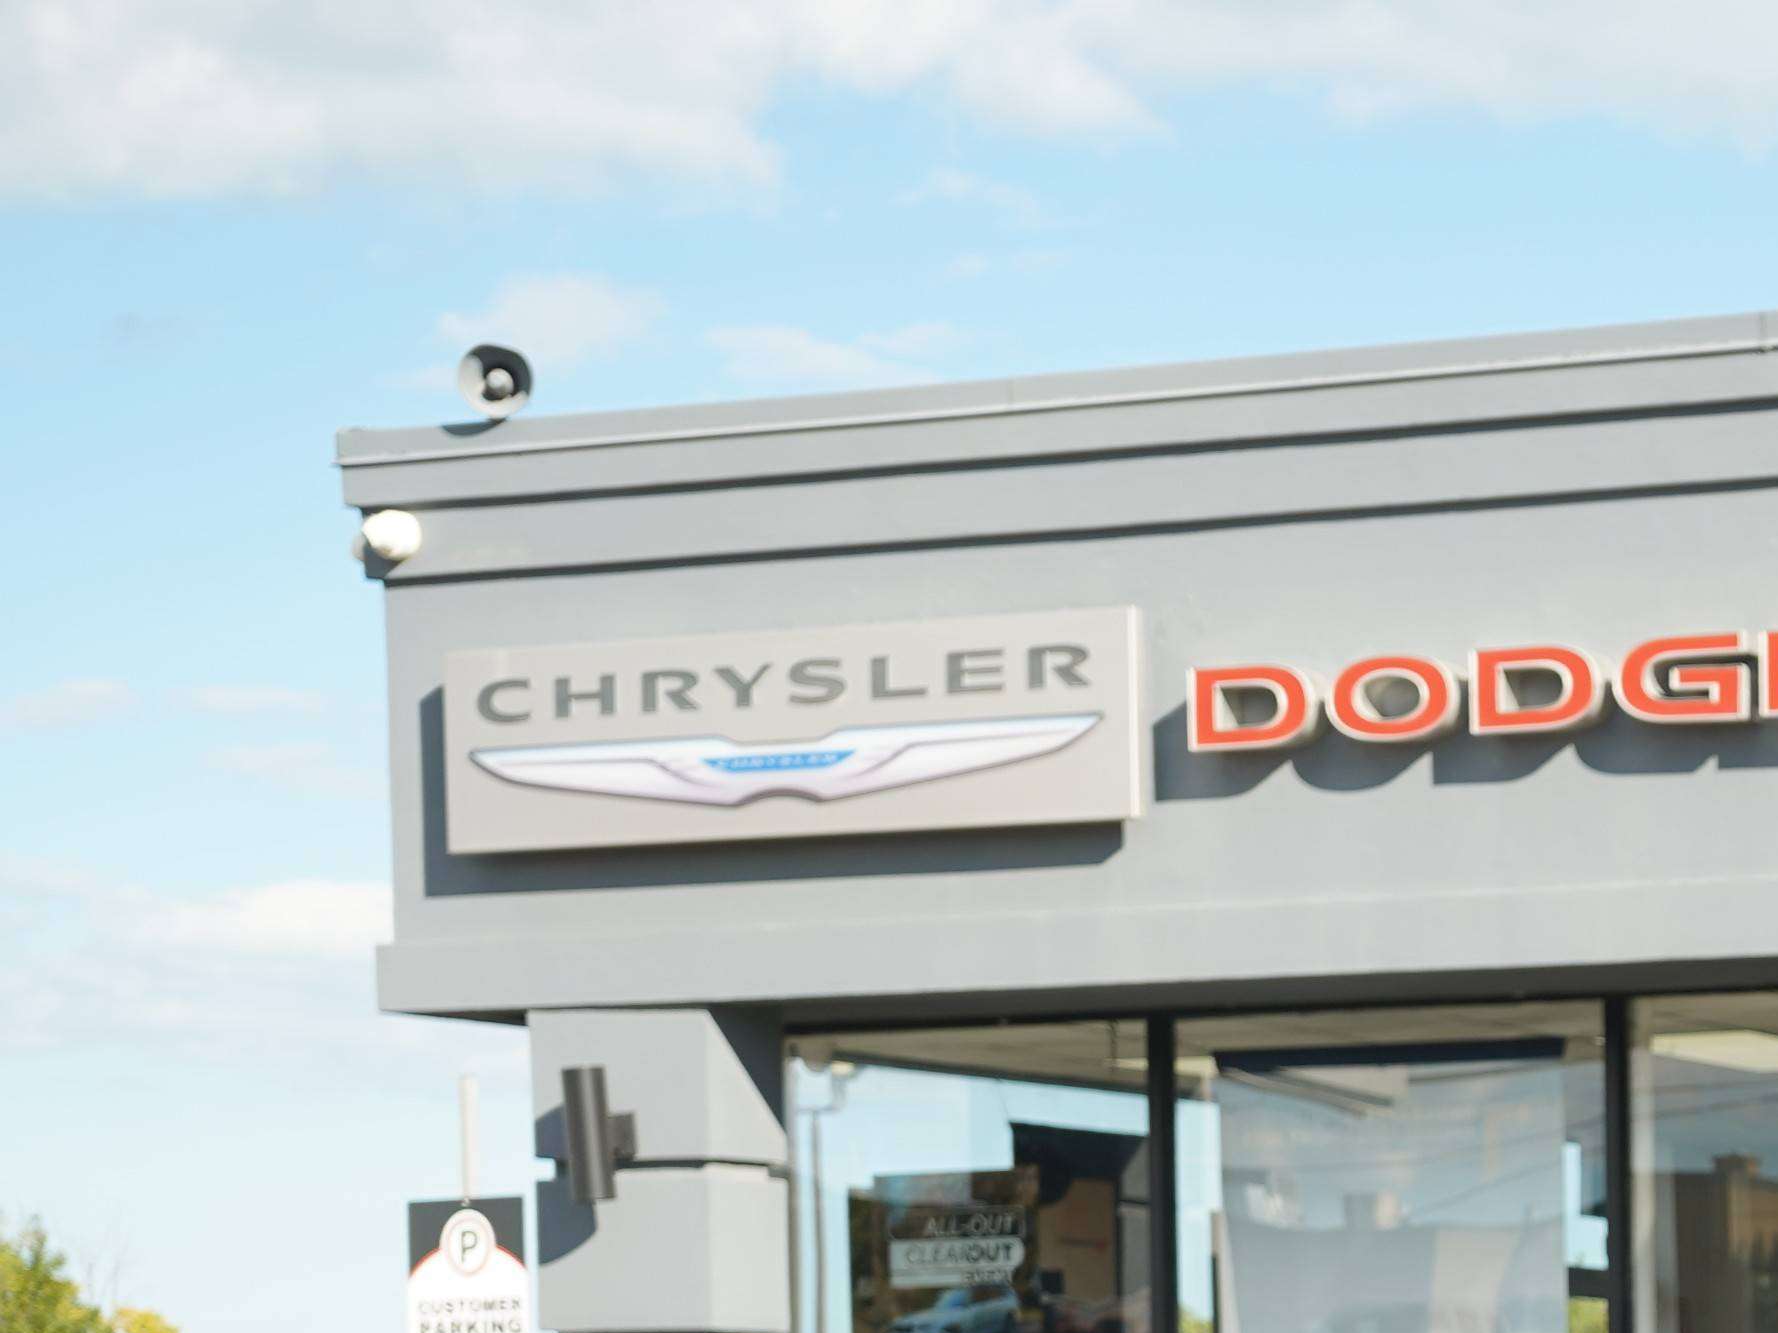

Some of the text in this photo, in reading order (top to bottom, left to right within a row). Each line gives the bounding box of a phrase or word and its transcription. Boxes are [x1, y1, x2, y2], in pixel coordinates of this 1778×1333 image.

[476, 642, 1092, 725] CHRYSLER
[461, 1230, 478, 1265] P
[418, 1298, 521, 1315] CUSTOMER
